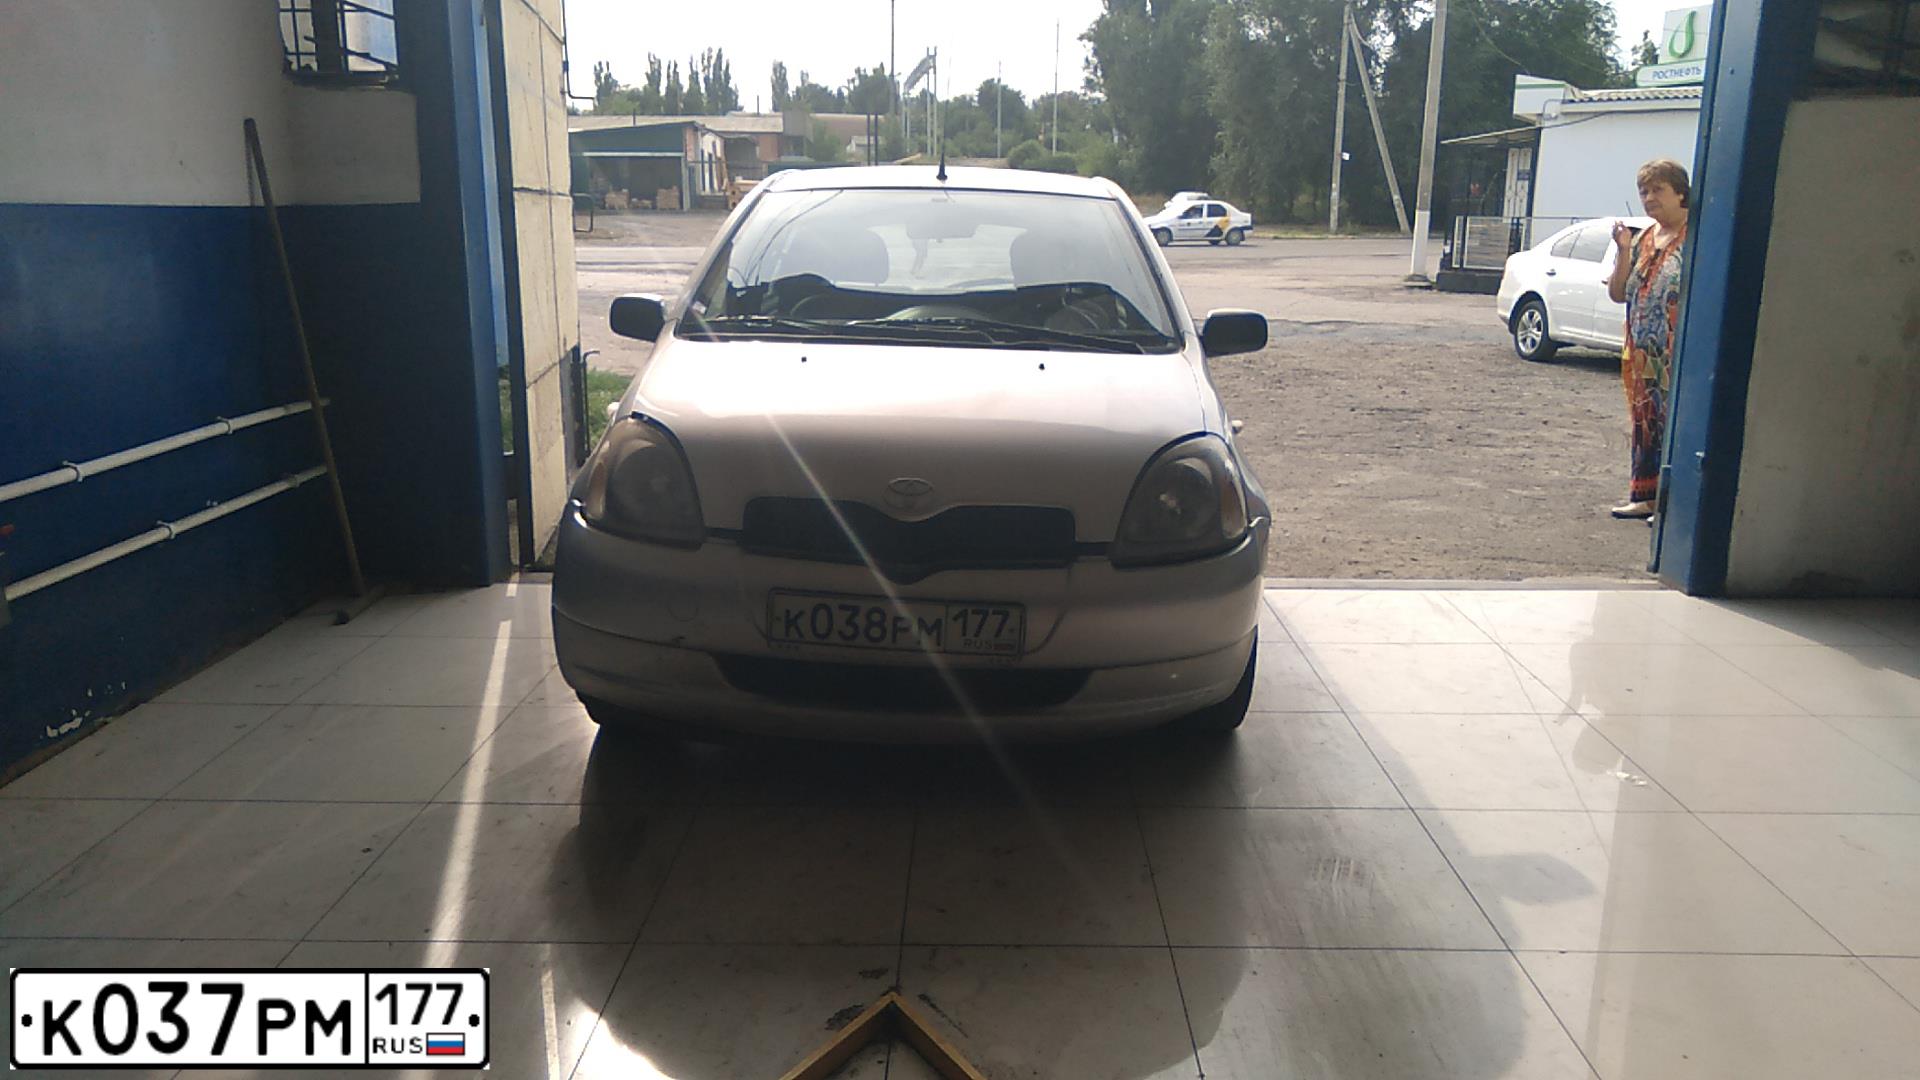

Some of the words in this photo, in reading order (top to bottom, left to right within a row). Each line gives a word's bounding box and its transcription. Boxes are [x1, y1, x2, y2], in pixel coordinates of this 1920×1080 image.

[1652, 66, 1702, 80] РОСТНЕФТЬ
[952, 609, 1011, 638] 177
[963, 639, 993, 650] RUS
